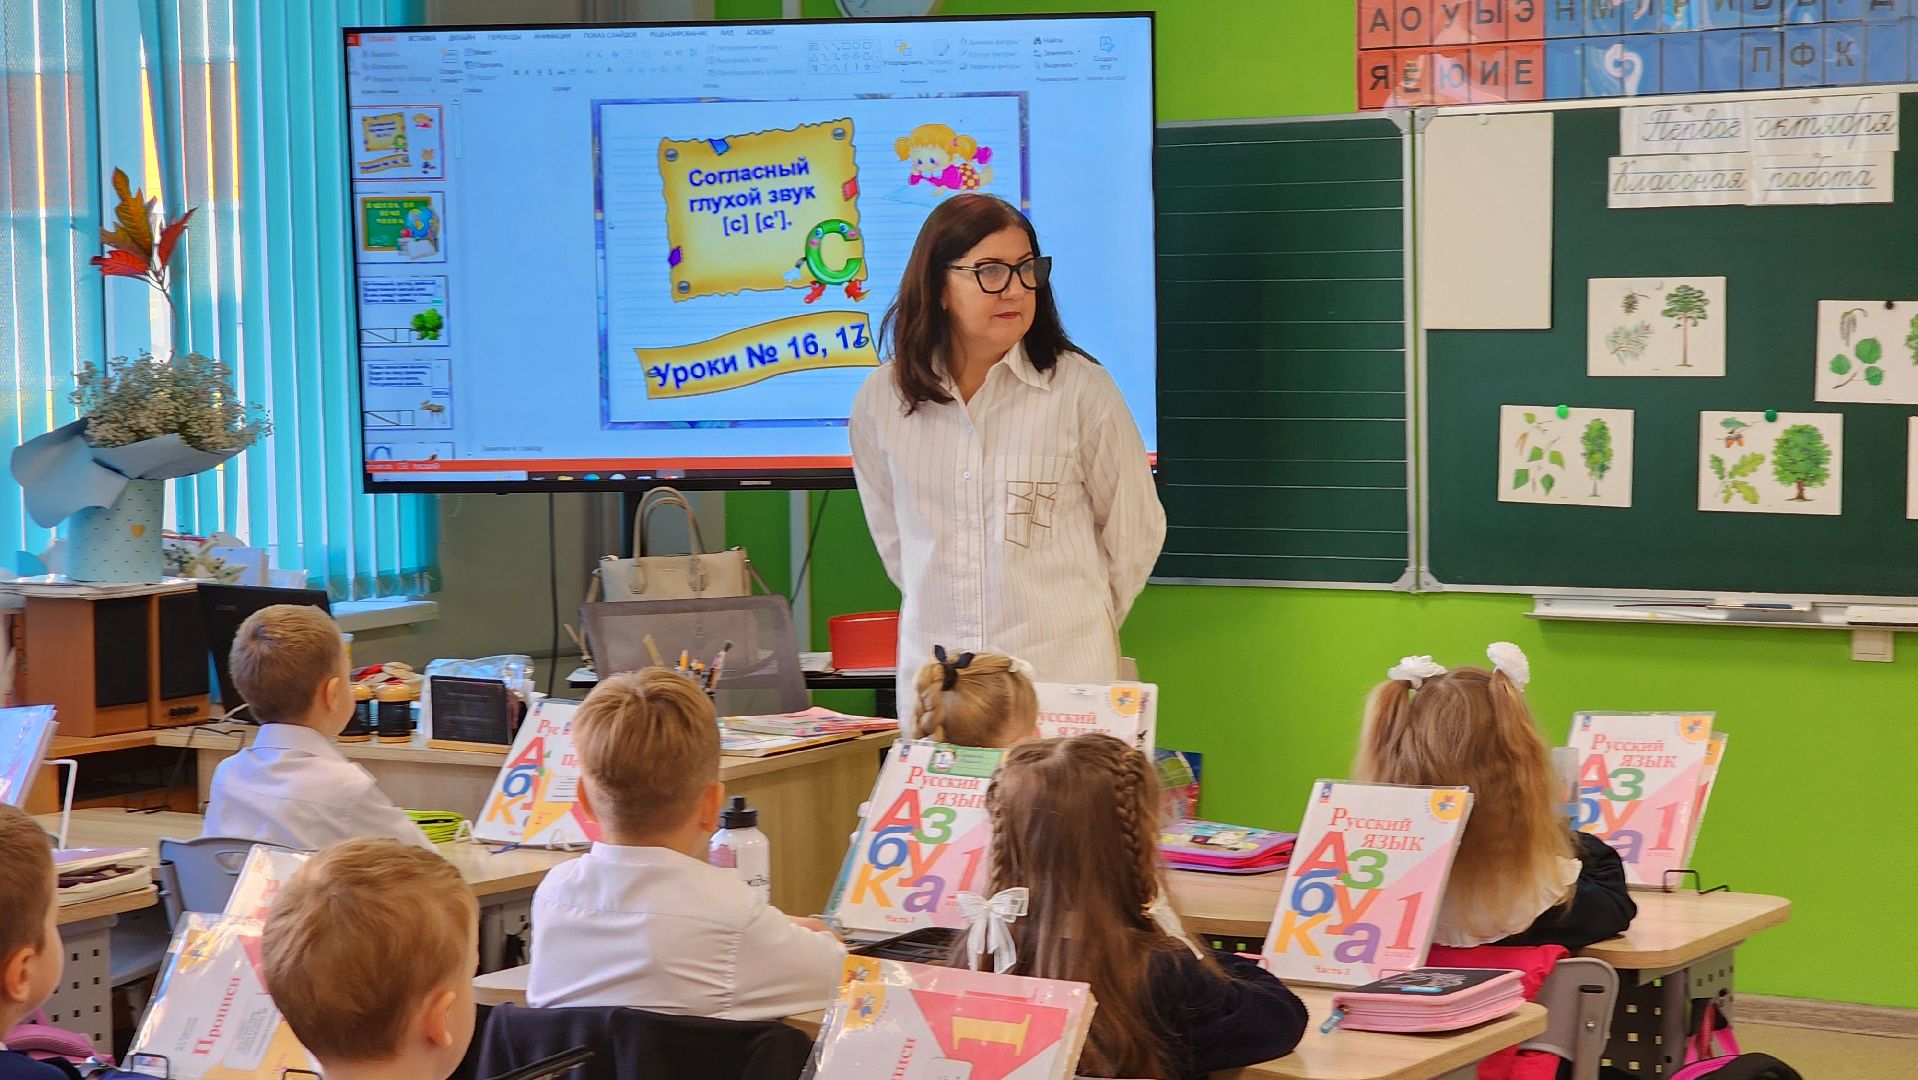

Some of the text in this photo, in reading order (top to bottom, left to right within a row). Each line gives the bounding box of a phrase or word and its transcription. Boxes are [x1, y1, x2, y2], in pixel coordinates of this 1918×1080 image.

[1642, 97, 1897, 153] Первое октября
[689, 157, 809, 187] Согласный
[1613, 155, 1876, 201] Классная работа
[689, 184, 816, 214] глухой звук
[723, 214, 749, 236] [с]
[655, 323, 866, 388] Уроки № 16, 17
[1038, 711, 1098, 725] усский
[1592, 733, 1665, 753] Русский
[1619, 755, 1678, 768] язык
[903, 765, 981, 791] Русский
[1328, 807, 1412, 831] Русский
[1360, 833, 1425, 851] язык
[1385, 891, 1424, 951] 1
